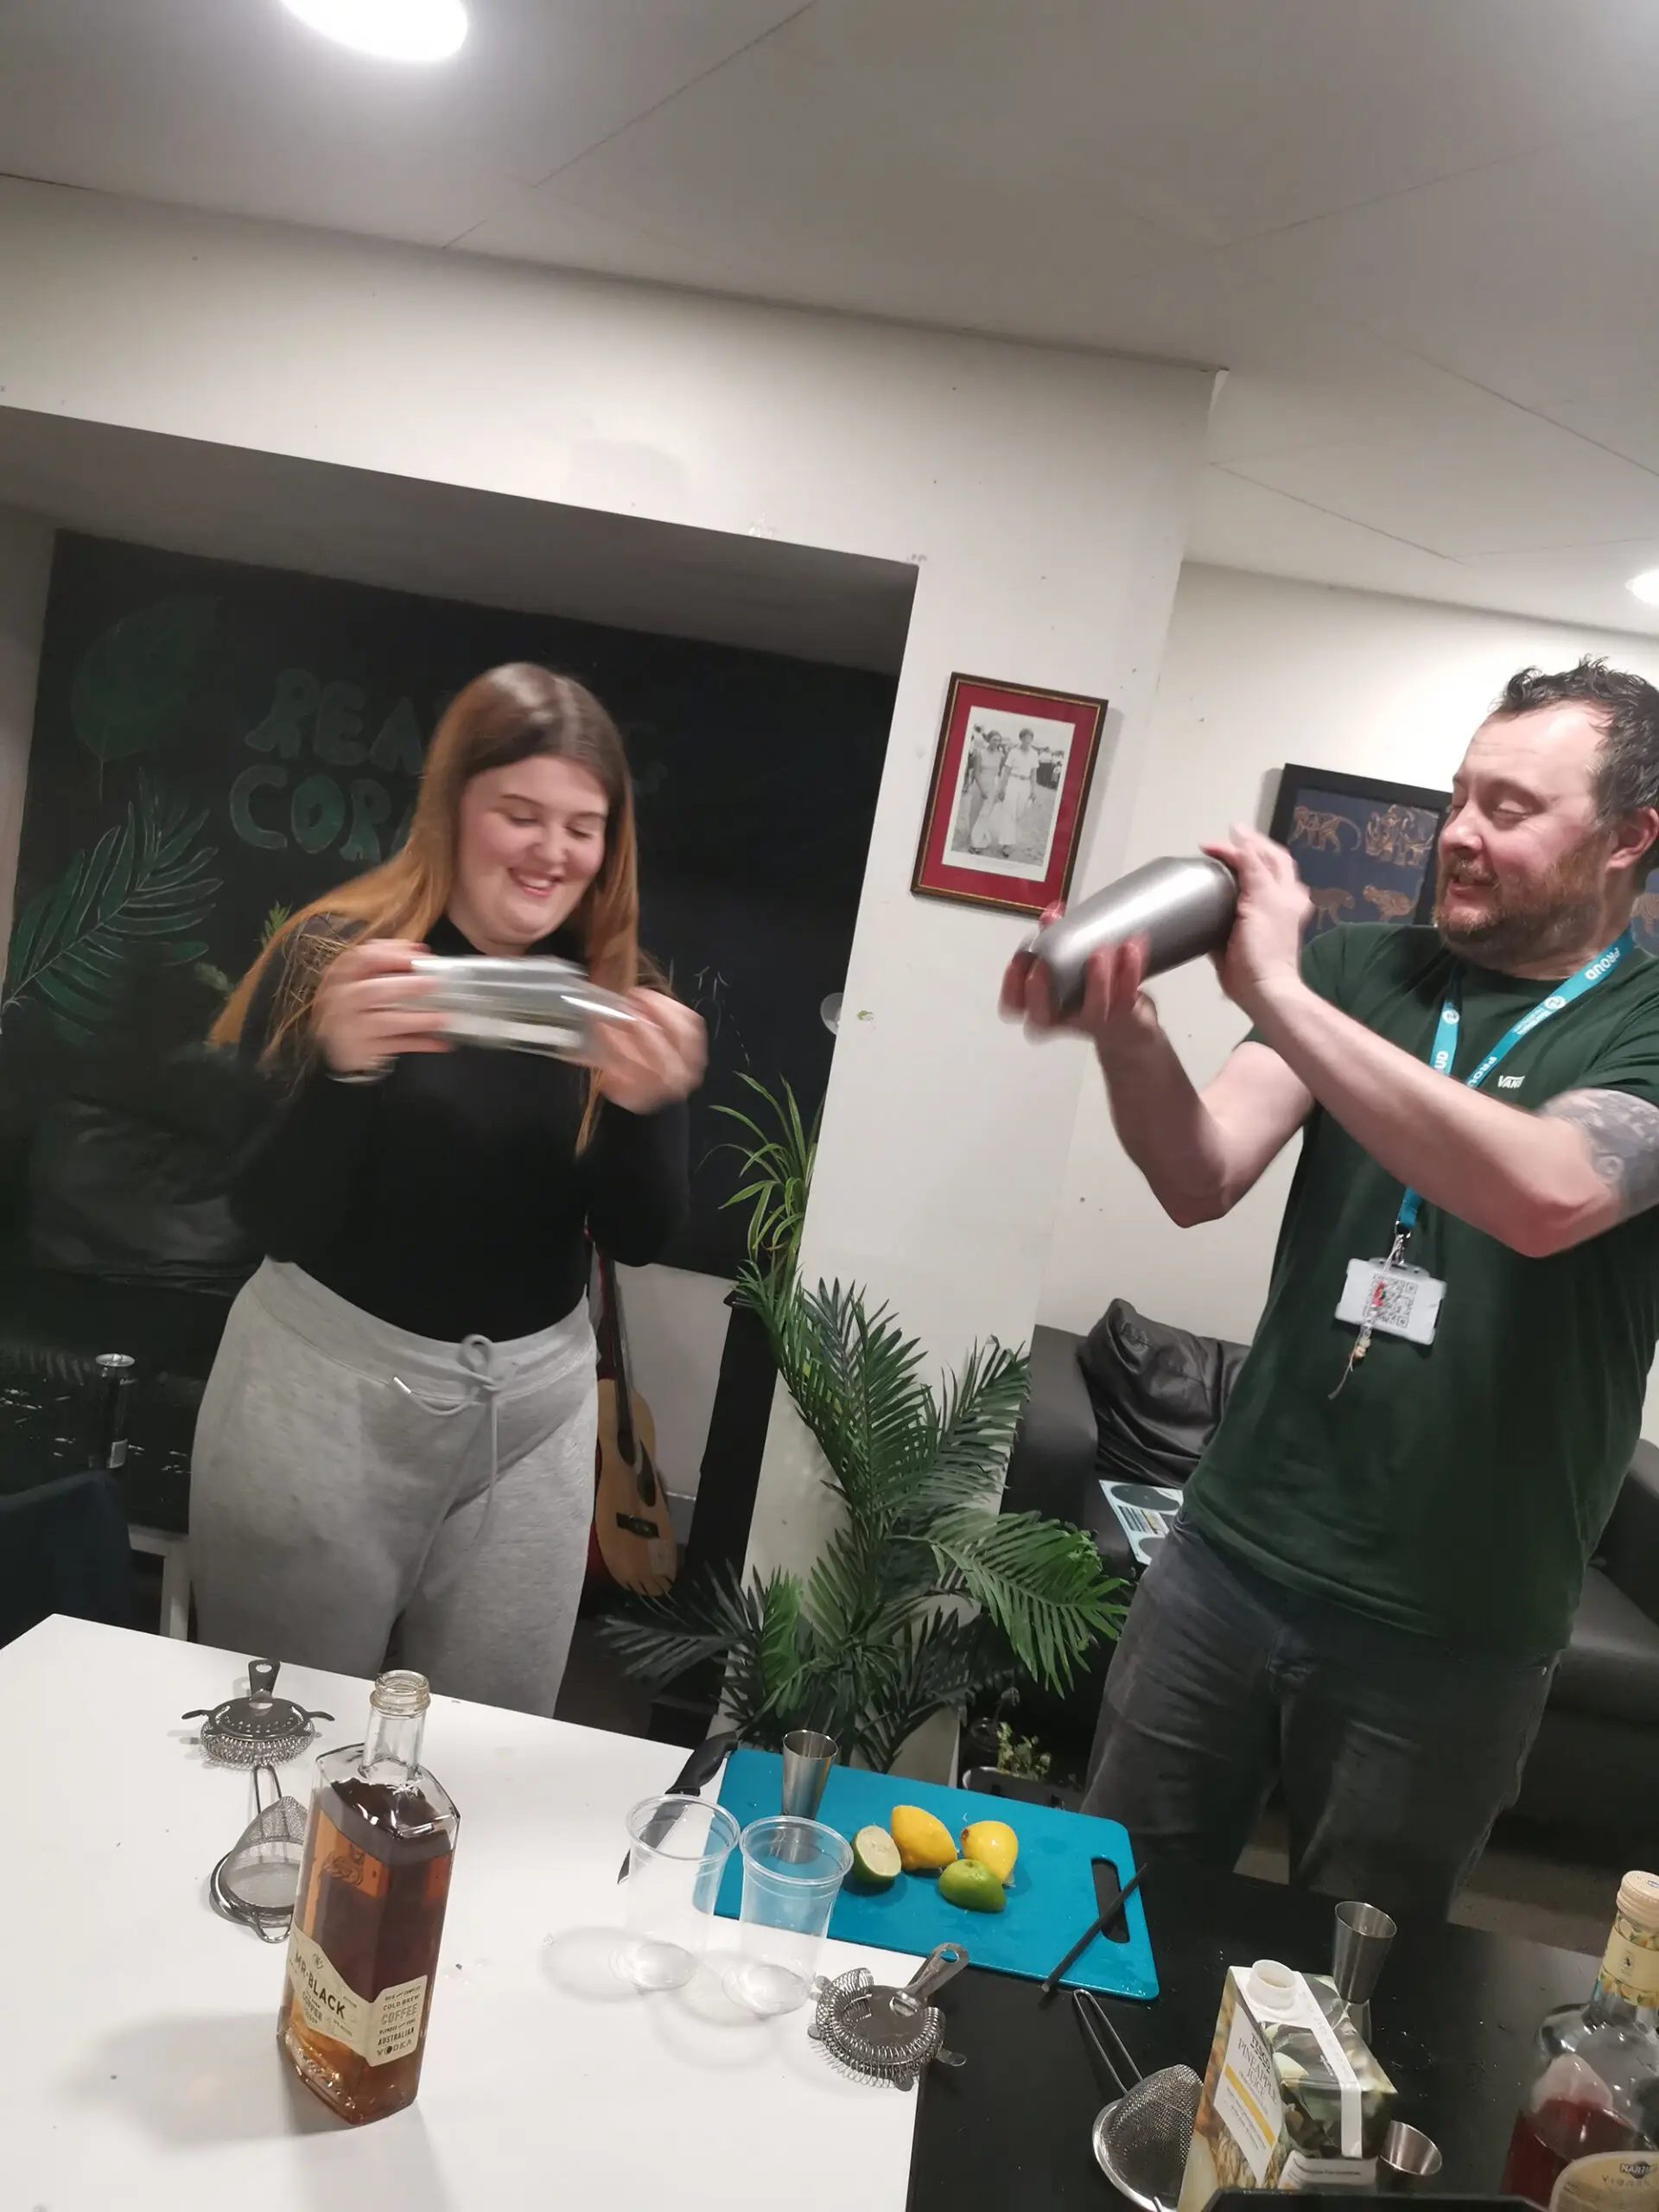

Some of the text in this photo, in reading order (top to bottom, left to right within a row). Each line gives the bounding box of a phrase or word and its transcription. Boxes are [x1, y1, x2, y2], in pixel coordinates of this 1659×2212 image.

[244, 668, 427, 775] REA
[229, 762, 413, 862] COR
[1585, 947, 1621, 980] PROUD
[1467, 1056, 1497, 1087] PROU
[308, 1971, 345, 2019] BLACK
[381, 2003, 418, 2025] COFFEE
